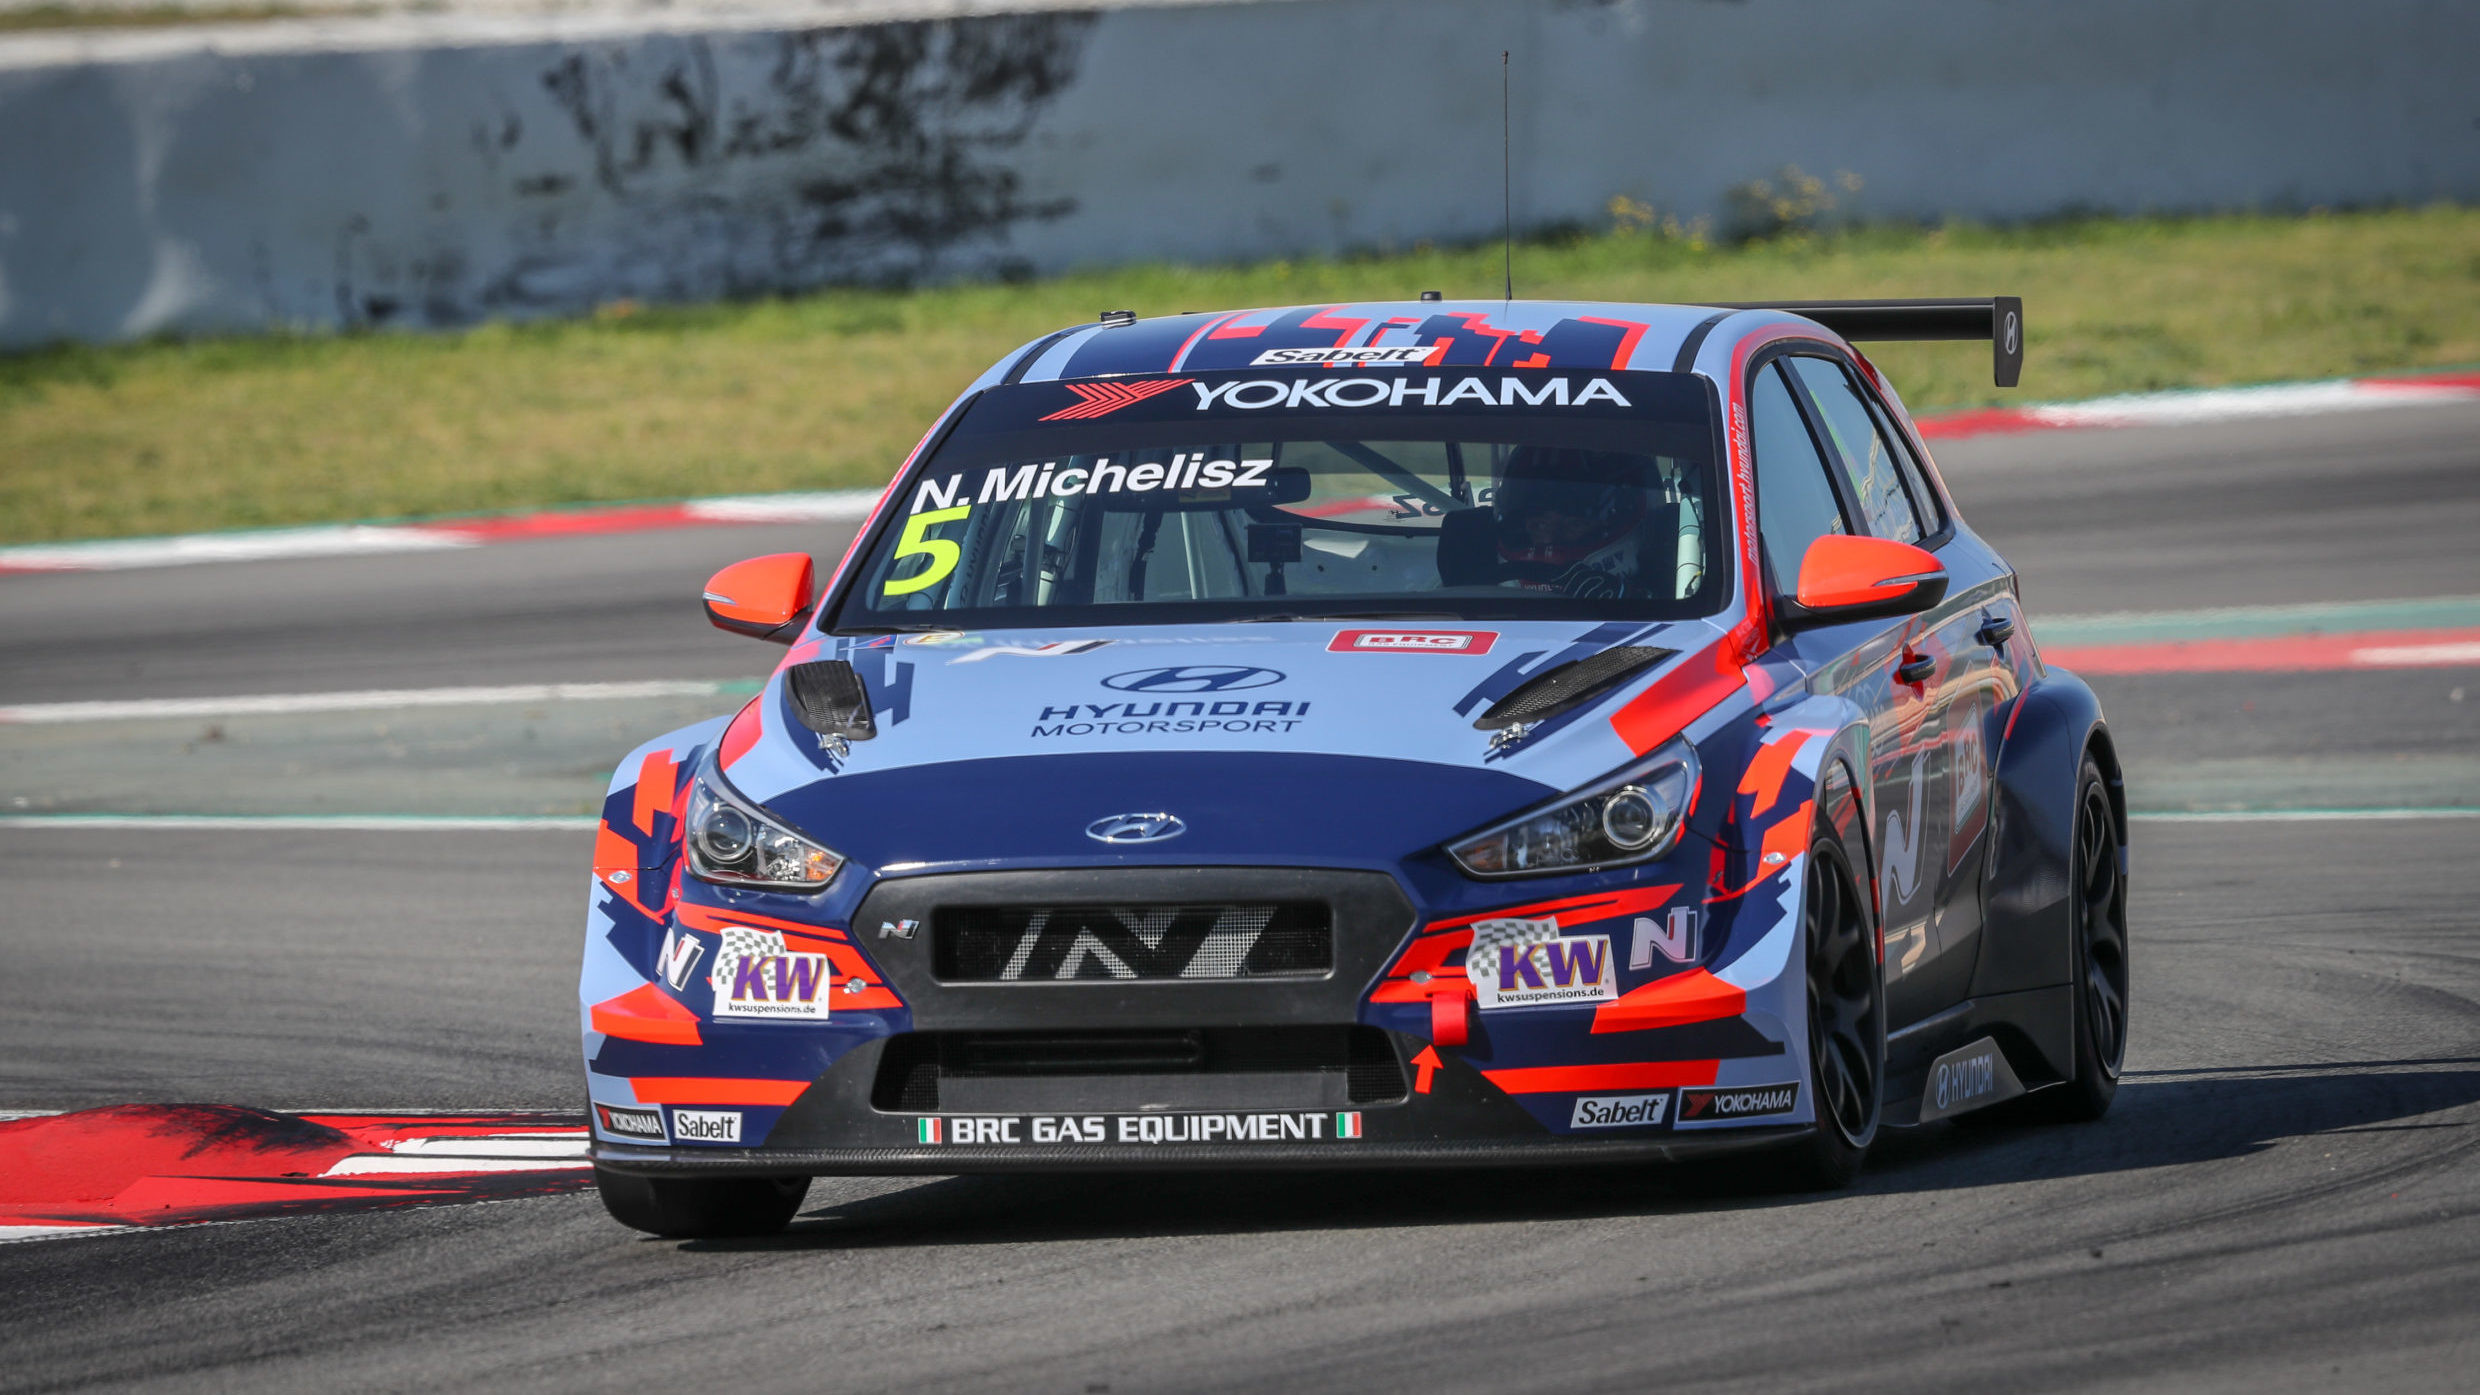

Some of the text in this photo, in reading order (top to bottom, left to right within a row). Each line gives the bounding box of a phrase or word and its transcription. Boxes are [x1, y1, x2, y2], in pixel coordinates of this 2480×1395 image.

[1265, 349, 1420, 363] Sabelt
[1191, 376, 1632, 411] YOKOHAMA
[909, 453, 1273, 515] N. Michelisz
[883, 505, 972, 596] 5
[1368, 635, 1458, 644] BRC
[1038, 701, 1311, 721] HYUNDAI
[1030, 720, 1303, 738] MOTORSPORT
[1499, 938, 1608, 992] KW
[731, 955, 823, 1002] KW
[1497, 987, 1604, 1004] kwsuspensions.de
[728, 1003, 816, 1014] kwsuspensions.de
[1951, 1053, 1993, 1102] HYUNDAI
[1578, 1100, 1658, 1124] Sabelt
[1714, 1090, 1792, 1113] YOKOHAMA
[608, 1111, 663, 1134] YOKOHAMA
[678, 1113, 736, 1138] Sabelt
[951, 1112, 1328, 1144] BRC GAS EQUIPMENT
